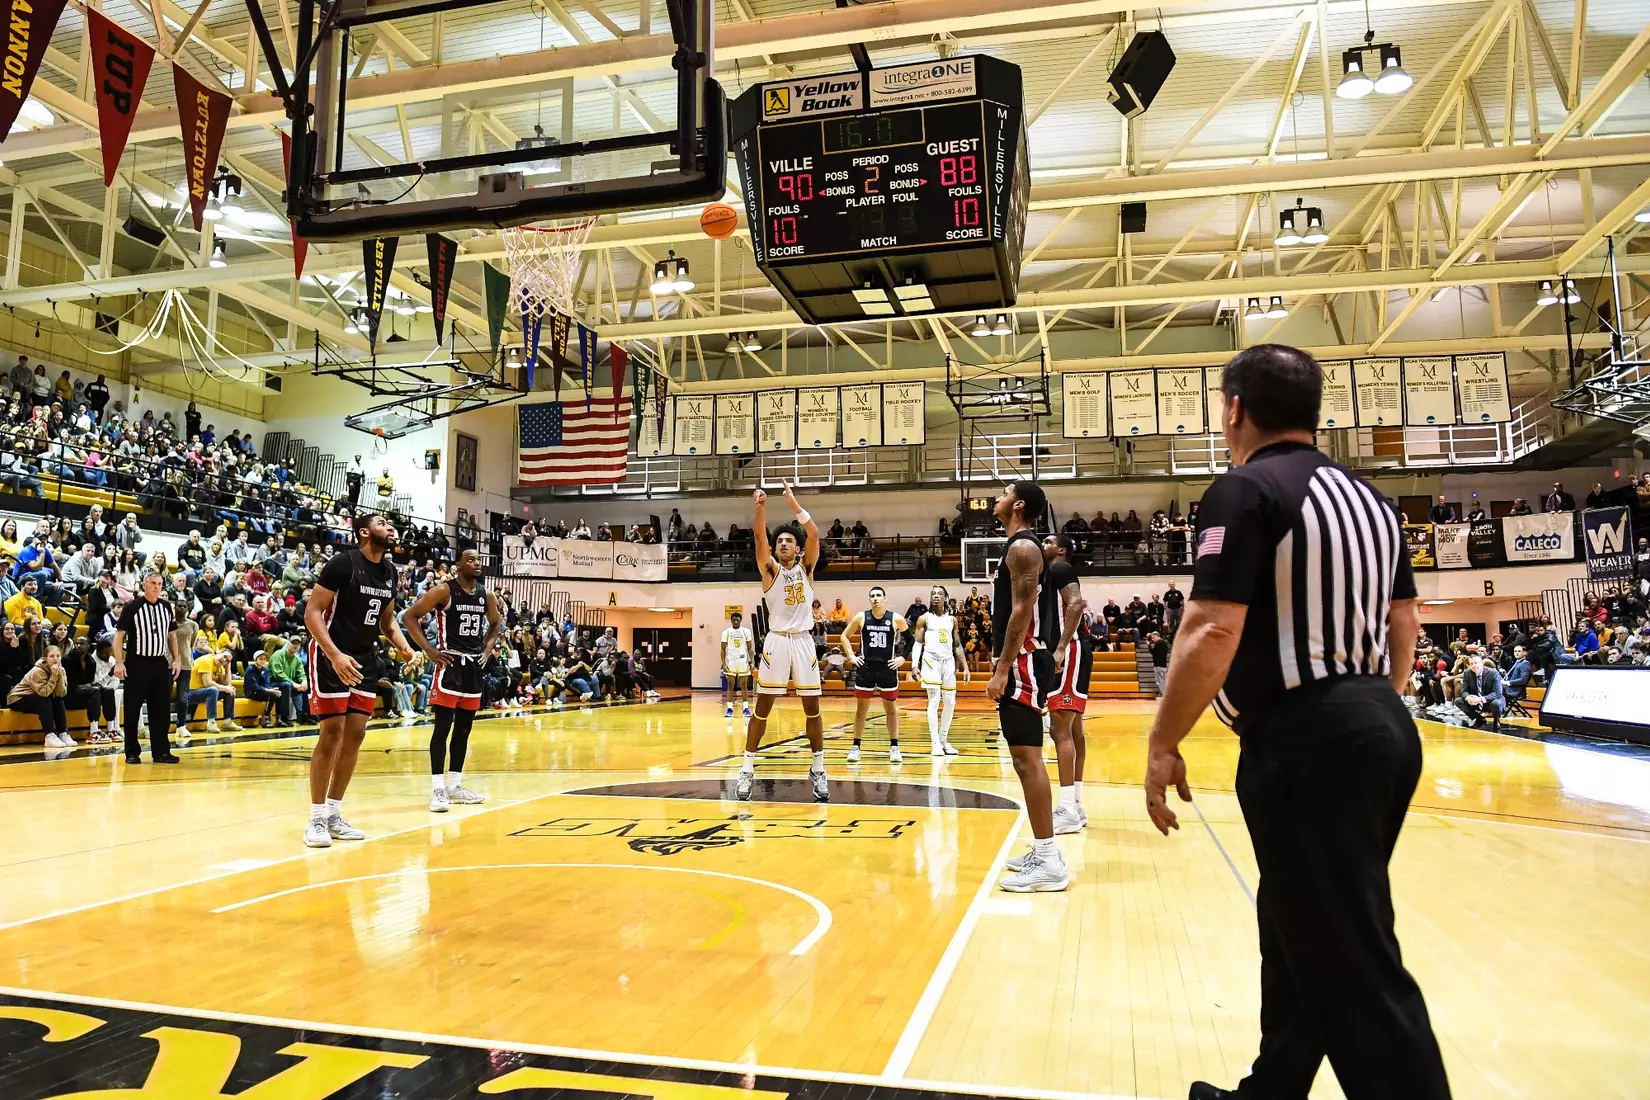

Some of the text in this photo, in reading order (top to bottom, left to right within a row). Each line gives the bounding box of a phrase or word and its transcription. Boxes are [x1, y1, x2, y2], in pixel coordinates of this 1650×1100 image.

[103, 29, 135, 117] IUP
[794, 80, 859, 98] Yellow
[801, 95, 854, 113] Book
[190, 90, 209, 200] KUTZTOWN
[926, 138, 980, 155] GUEST
[770, 156, 813, 173] VILLE
[852, 155, 890, 167] PERIOD
[894, 163, 919, 174] POSS
[825, 170, 849, 181] POSS
[940, 155, 977, 186] 88
[993, 107, 1008, 238] MILLERSVILLE
[778, 174, 813, 201] 90
[864, 166, 880, 194] 2
[889, 178, 920, 190] BONUS
[826, 185, 856, 197] BONUS
[948, 185, 982, 197] FOULS
[741, 138, 764, 262] MILLERSVILLE
[845, 192, 919, 208] PLAYER FOUL
[768, 204, 800, 216] FOULS
[954, 198, 979, 227] 10
[773, 217, 797, 245] 10
[945, 228, 984, 240] SCORE
[860, 236, 897, 248] MATCH
[769, 245, 805, 257] SCORE
[371, 237, 385, 312] ERSVILLE
[585, 330, 593, 395] SHEPHERD
[133, 393, 139, 405] A
[970, 499, 988, 510] 16.0
[1438, 527, 1462, 535] MAKE
[1470, 529, 1496, 537] VALLEY
[1515, 537, 1560, 550] CALECO
[506, 545, 558, 562] UPMC
[572, 554, 612, 562] Northwestern
[1590, 556, 1631, 568] WEAVER
[360, 585, 392, 598] WARRIORS
[784, 582, 806, 606] 32
[1484, 580, 1494, 596] B
[608, 592, 617, 606] A
[364, 598, 382, 626] 2
[456, 604, 485, 613] WARRIORS
[459, 613, 481, 636] 23
[869, 632, 887, 648] 30
[938, 628, 948, 644] 2
